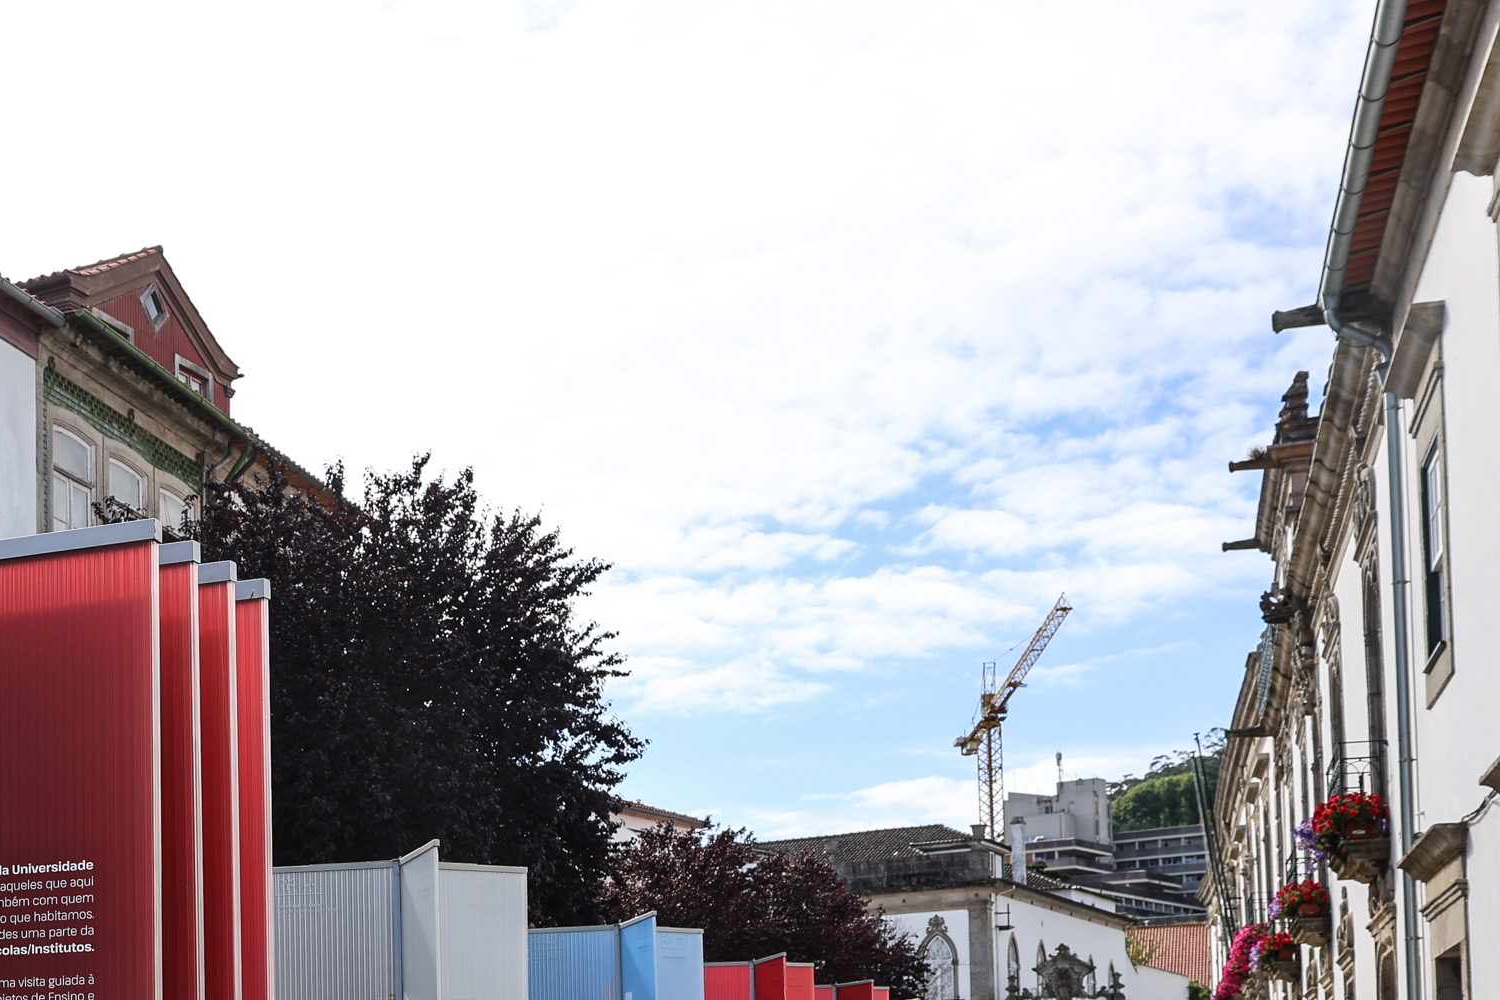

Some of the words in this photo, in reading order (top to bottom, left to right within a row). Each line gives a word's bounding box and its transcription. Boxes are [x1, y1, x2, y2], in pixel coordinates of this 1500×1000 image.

[12, 860, 93, 874] Universidade
[0, 880, 42, 893] aqueles
[46, 880, 67, 890] que
[70, 876, 93, 889] aqui
[33, 897, 57, 905] com
[61, 895, 93, 906] quem
[10, 914, 30, 925] que
[34, 911, 94, 921] habitamos.
[21, 930, 45, 938] uma
[49, 927, 77, 939] parte
[18, 977, 45, 987] visita
[49, 975, 85, 988] guiada
